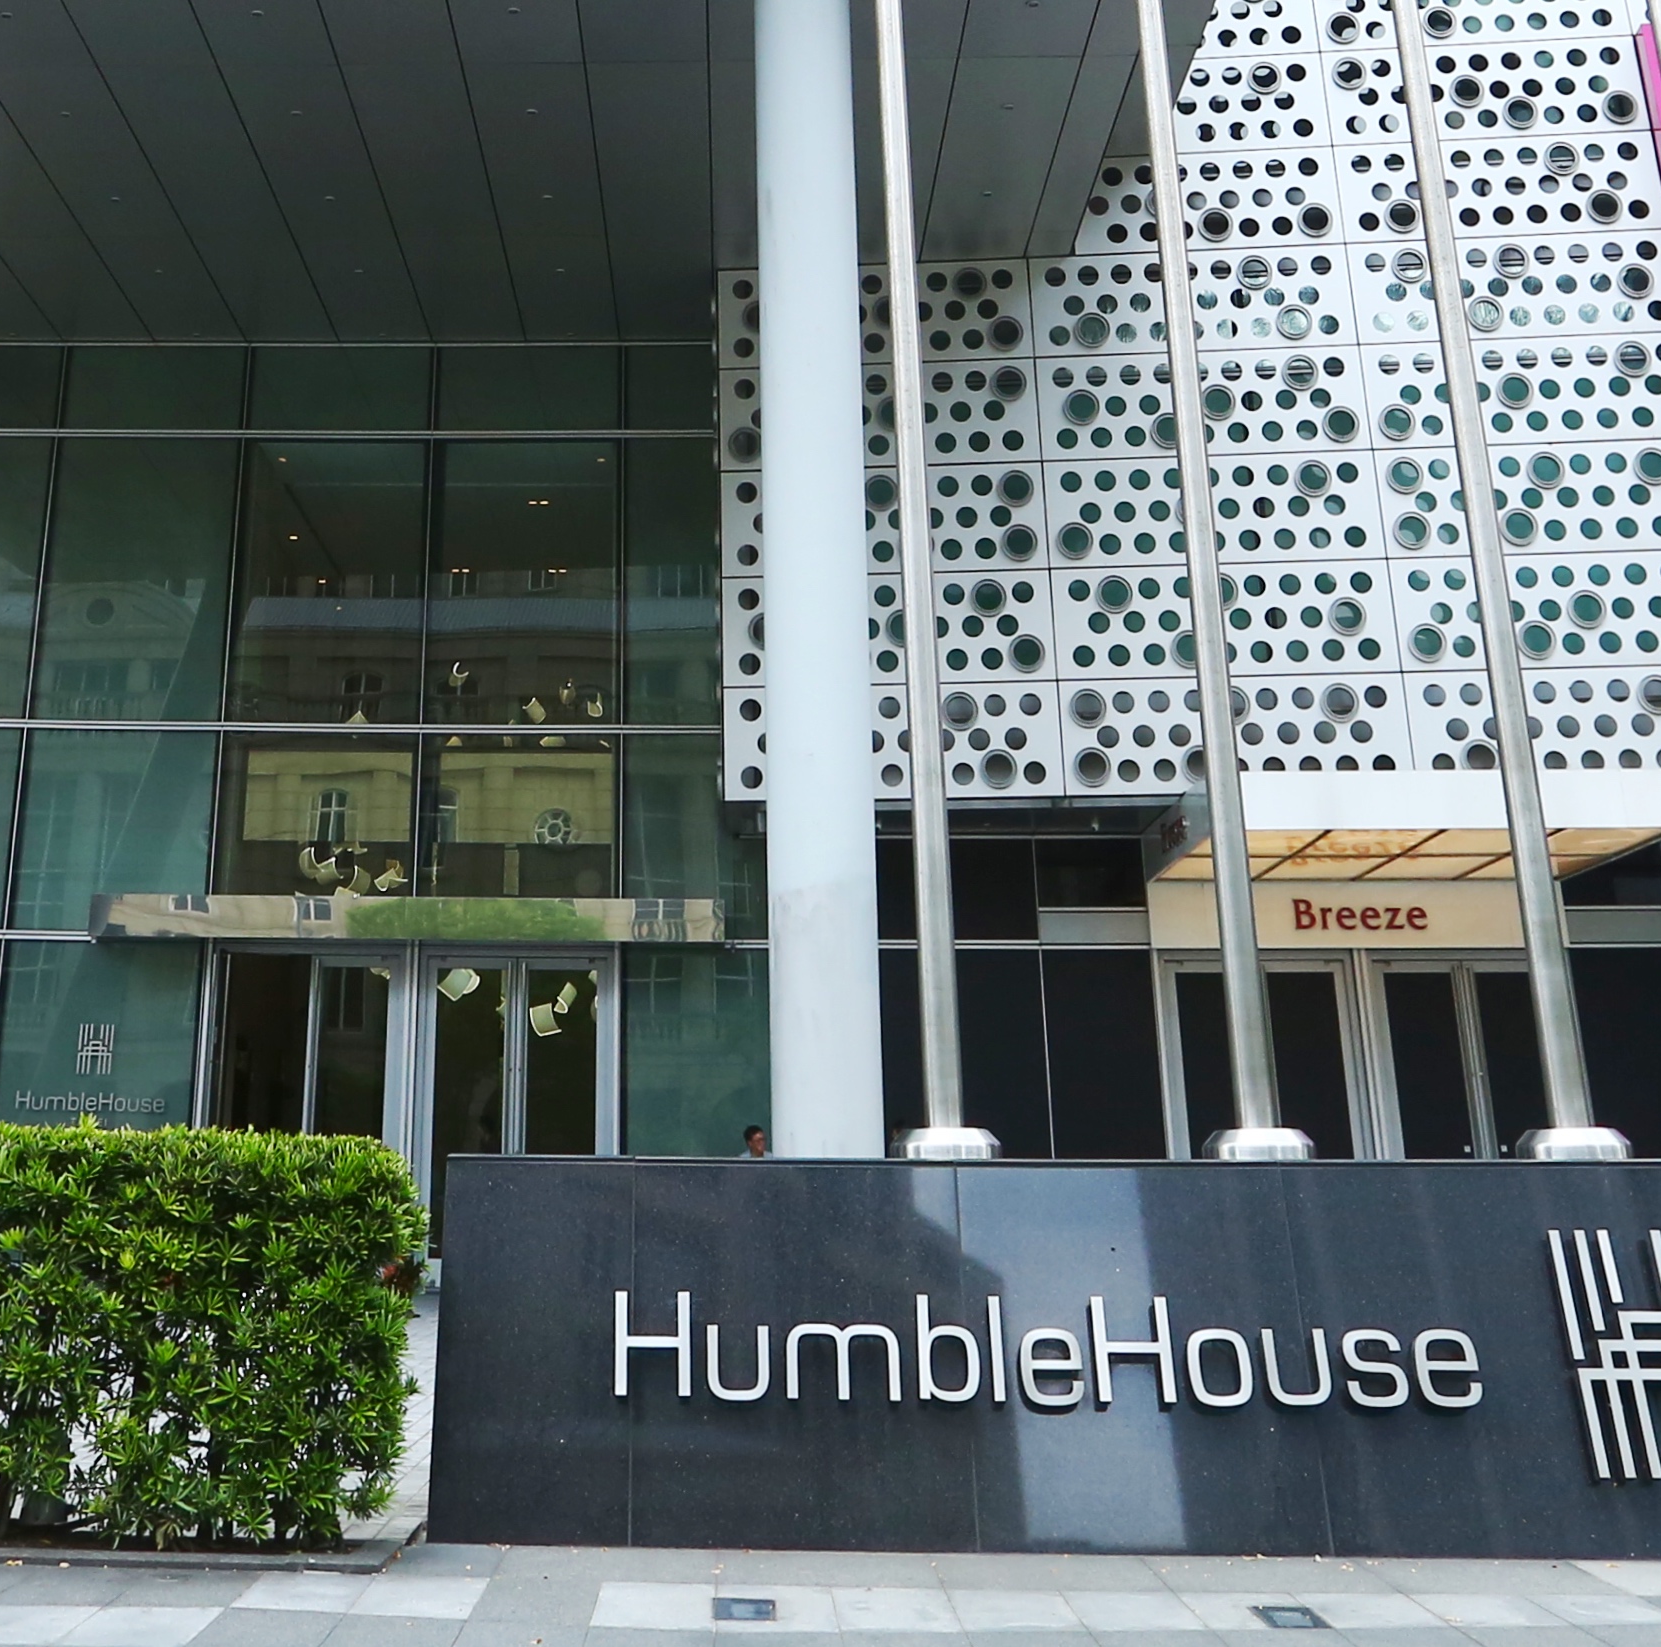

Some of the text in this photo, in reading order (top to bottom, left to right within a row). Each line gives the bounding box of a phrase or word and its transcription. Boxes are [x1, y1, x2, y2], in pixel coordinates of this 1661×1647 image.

[1292, 899, 1428, 930] Breeze
[15, 1090, 165, 1112] HumbleHouse
[613, 1290, 1484, 1408] HumbleHouse
